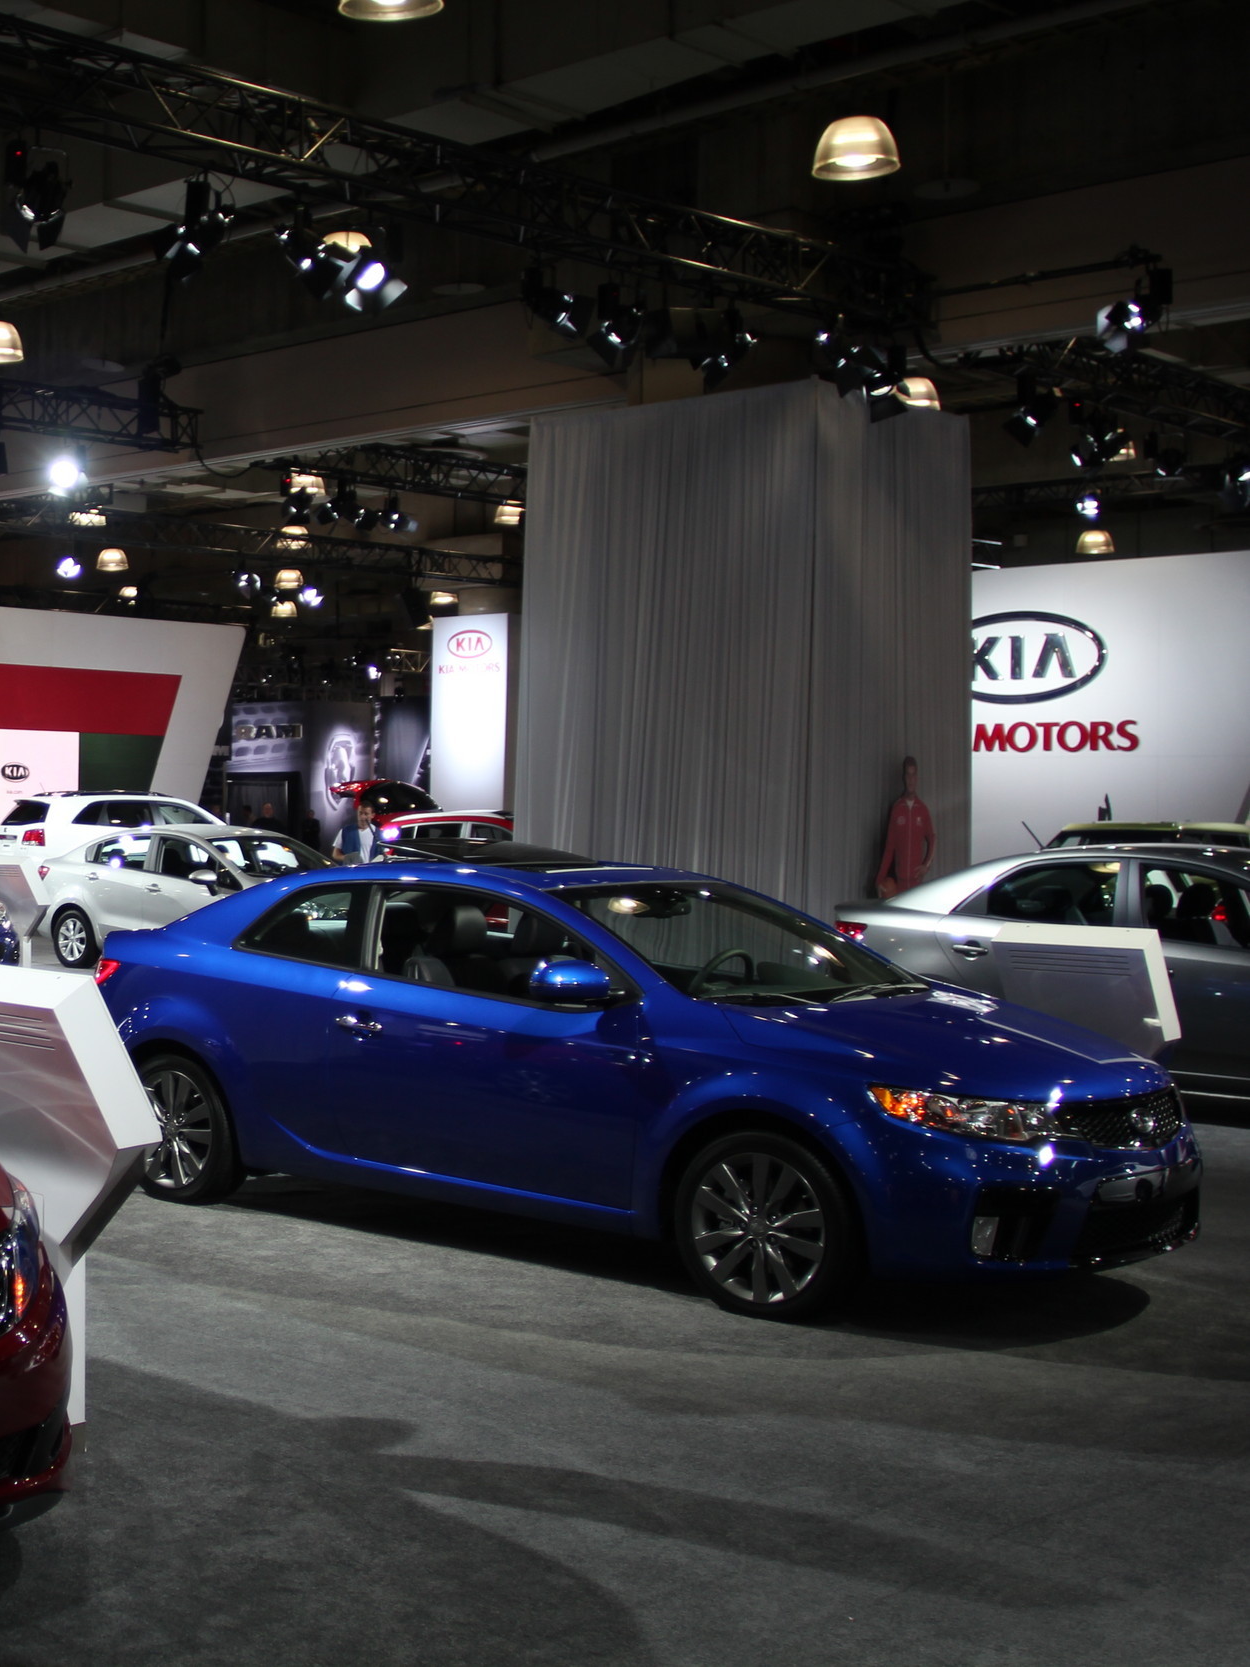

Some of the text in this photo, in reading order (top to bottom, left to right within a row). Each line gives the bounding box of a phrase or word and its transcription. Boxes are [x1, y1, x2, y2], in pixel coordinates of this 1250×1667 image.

[456, 636, 485, 652] KIA
[971, 632, 1077, 682] KIA
[459, 662, 501, 673] MORS
[972, 719, 1140, 753] MOTORS
[4, 766, 26, 778] KIA
